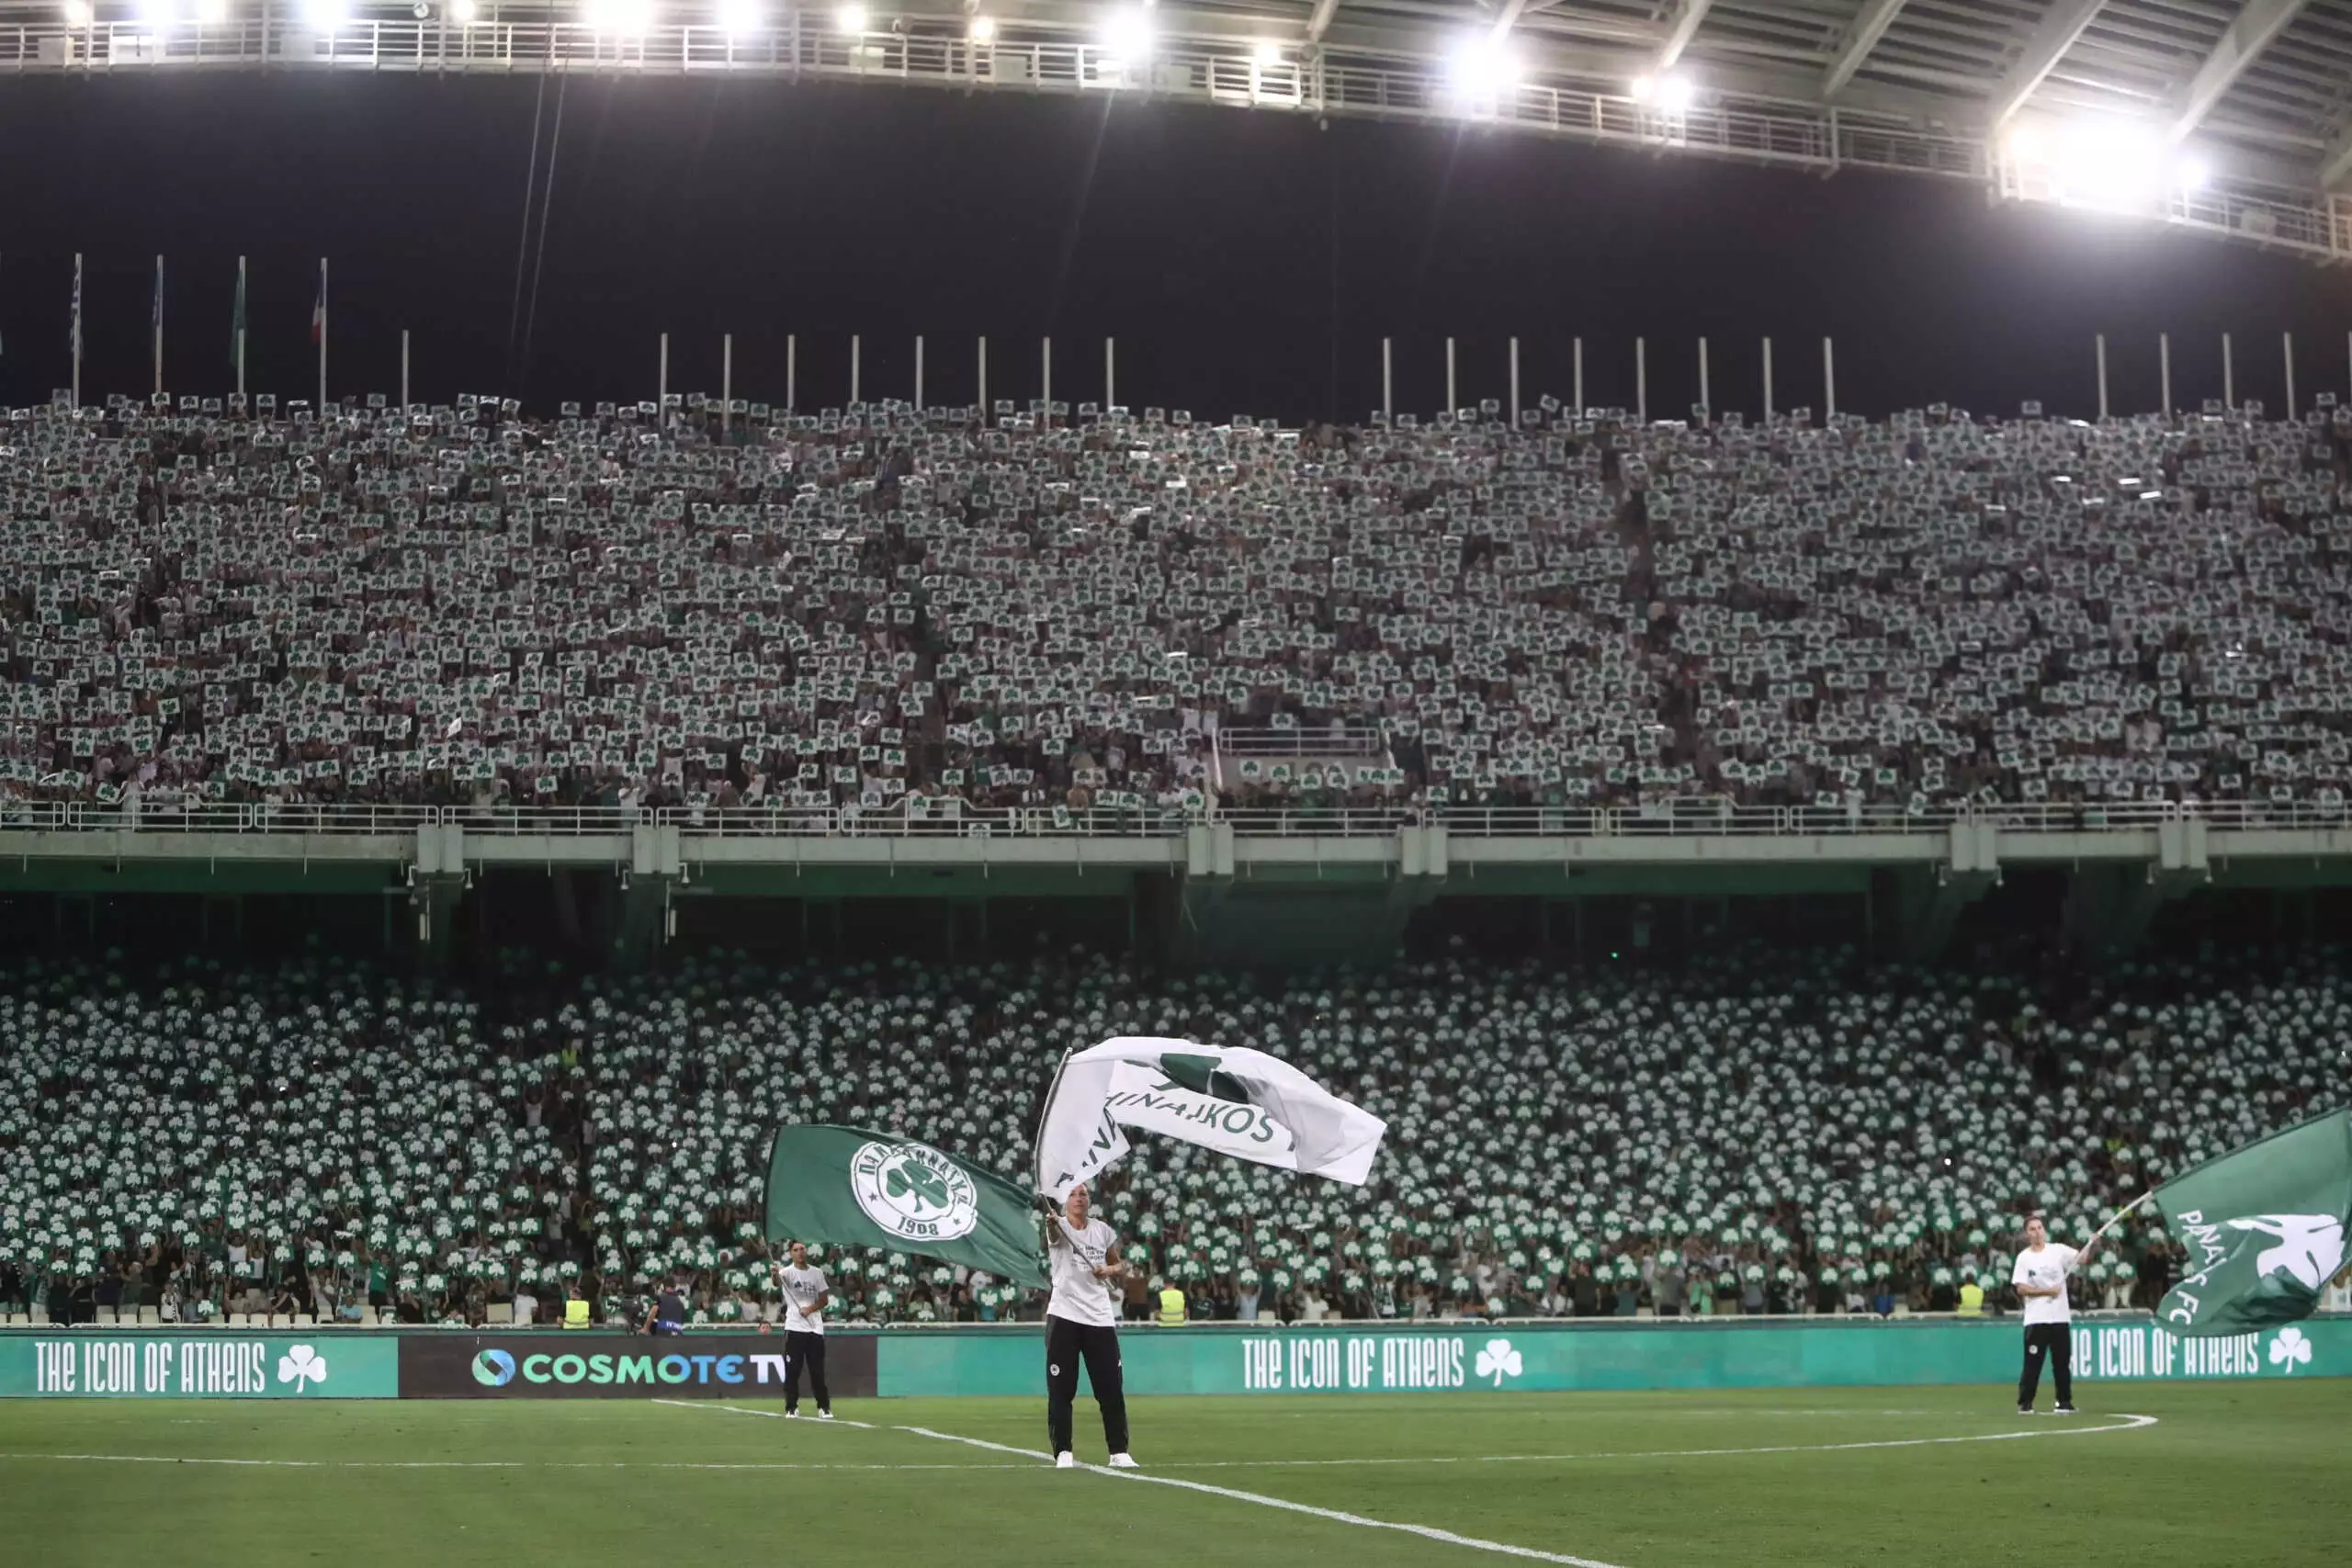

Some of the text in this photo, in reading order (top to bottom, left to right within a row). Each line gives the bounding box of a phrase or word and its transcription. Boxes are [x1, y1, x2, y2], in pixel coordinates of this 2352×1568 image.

[897, 1216, 939, 1236] 1908
[2169, 1290, 2199, 1325] FC
[144, 1342, 173, 1392] OF
[523, 1354, 744, 1384] COSMOTE
[1348, 1338, 1375, 1388] OF
[2152, 1328, 2178, 1375] OF
